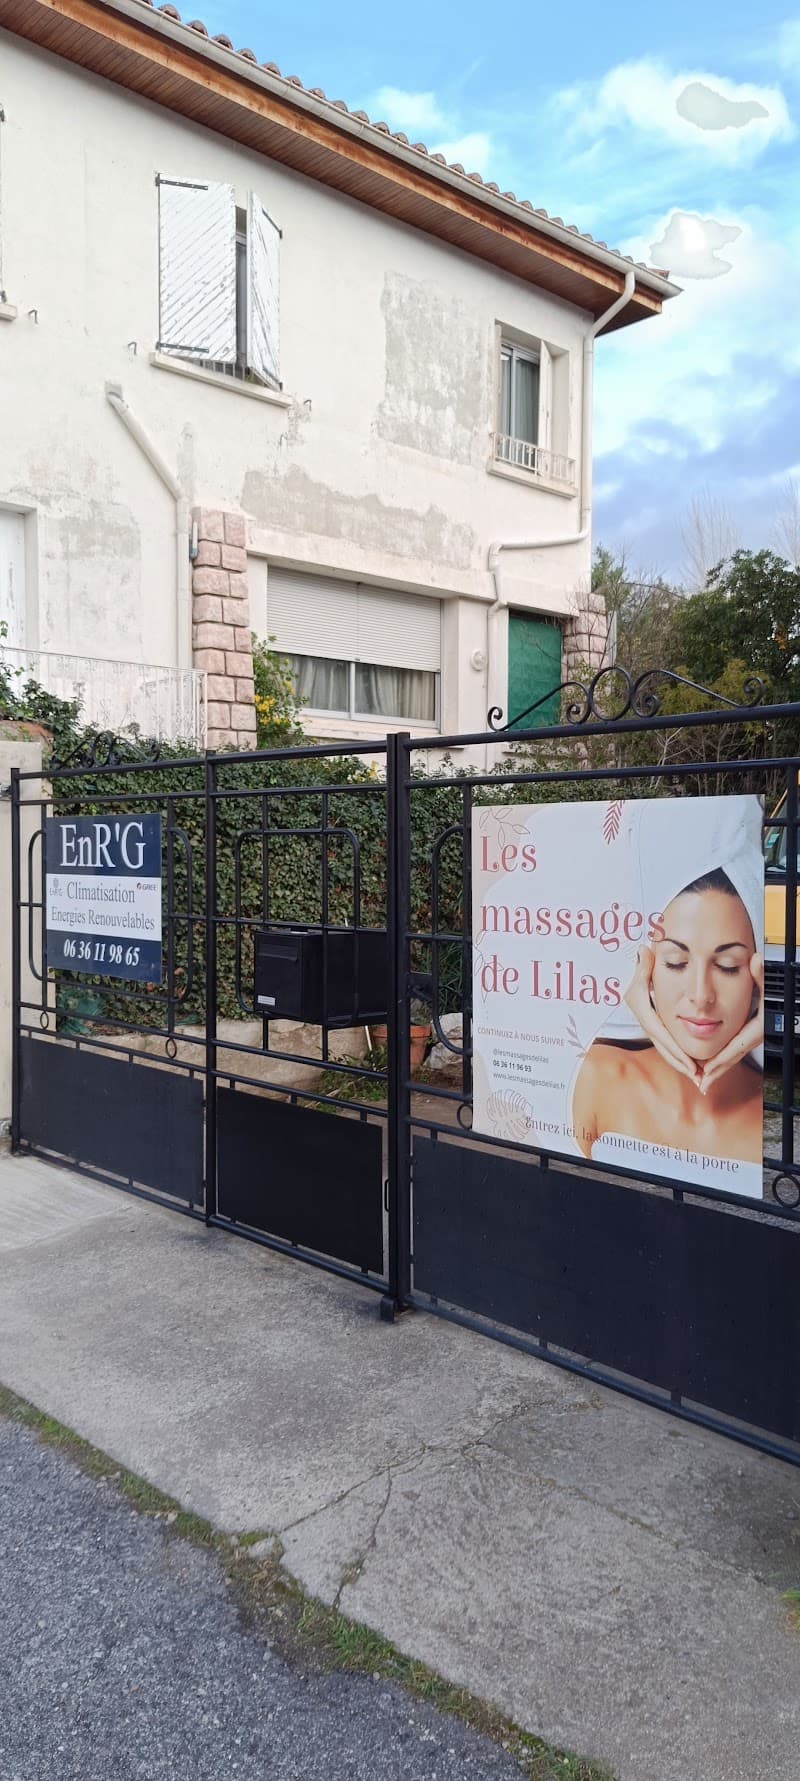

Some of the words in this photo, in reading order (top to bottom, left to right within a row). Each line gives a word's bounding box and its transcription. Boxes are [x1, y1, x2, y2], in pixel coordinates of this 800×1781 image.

[59, 821, 146, 870] EnR'G
[479, 835, 537, 873] Les
[67, 881, 136, 904] Climatisation
[51, 906, 86, 927] Energies
[88, 908, 156, 931] Renouvelables
[479, 902, 666, 953] massages
[63, 938, 76, 958] 06
[78, 940, 92, 960] 36
[93, 942, 106, 962] 11
[108, 944, 123, 964] 98
[125, 946, 140, 967] 65
[480, 954, 520, 995] de
[530, 959, 623, 1007] Lilas
[477, 1026, 513, 1039] CONTINUEZ
[514, 1032, 520, 1040] À
[520, 1033, 540, 1043] NOUS
[540, 1036, 565, 1047] SUIVRE
[508, 1062, 515, 1070] 11
[582, 1127, 593, 1142] la
[595, 1134, 649, 1155] sonnette
[652, 1143, 670, 1160] est
[686, 1148, 698, 1165] la
[702, 1155, 740, 1173] porte
